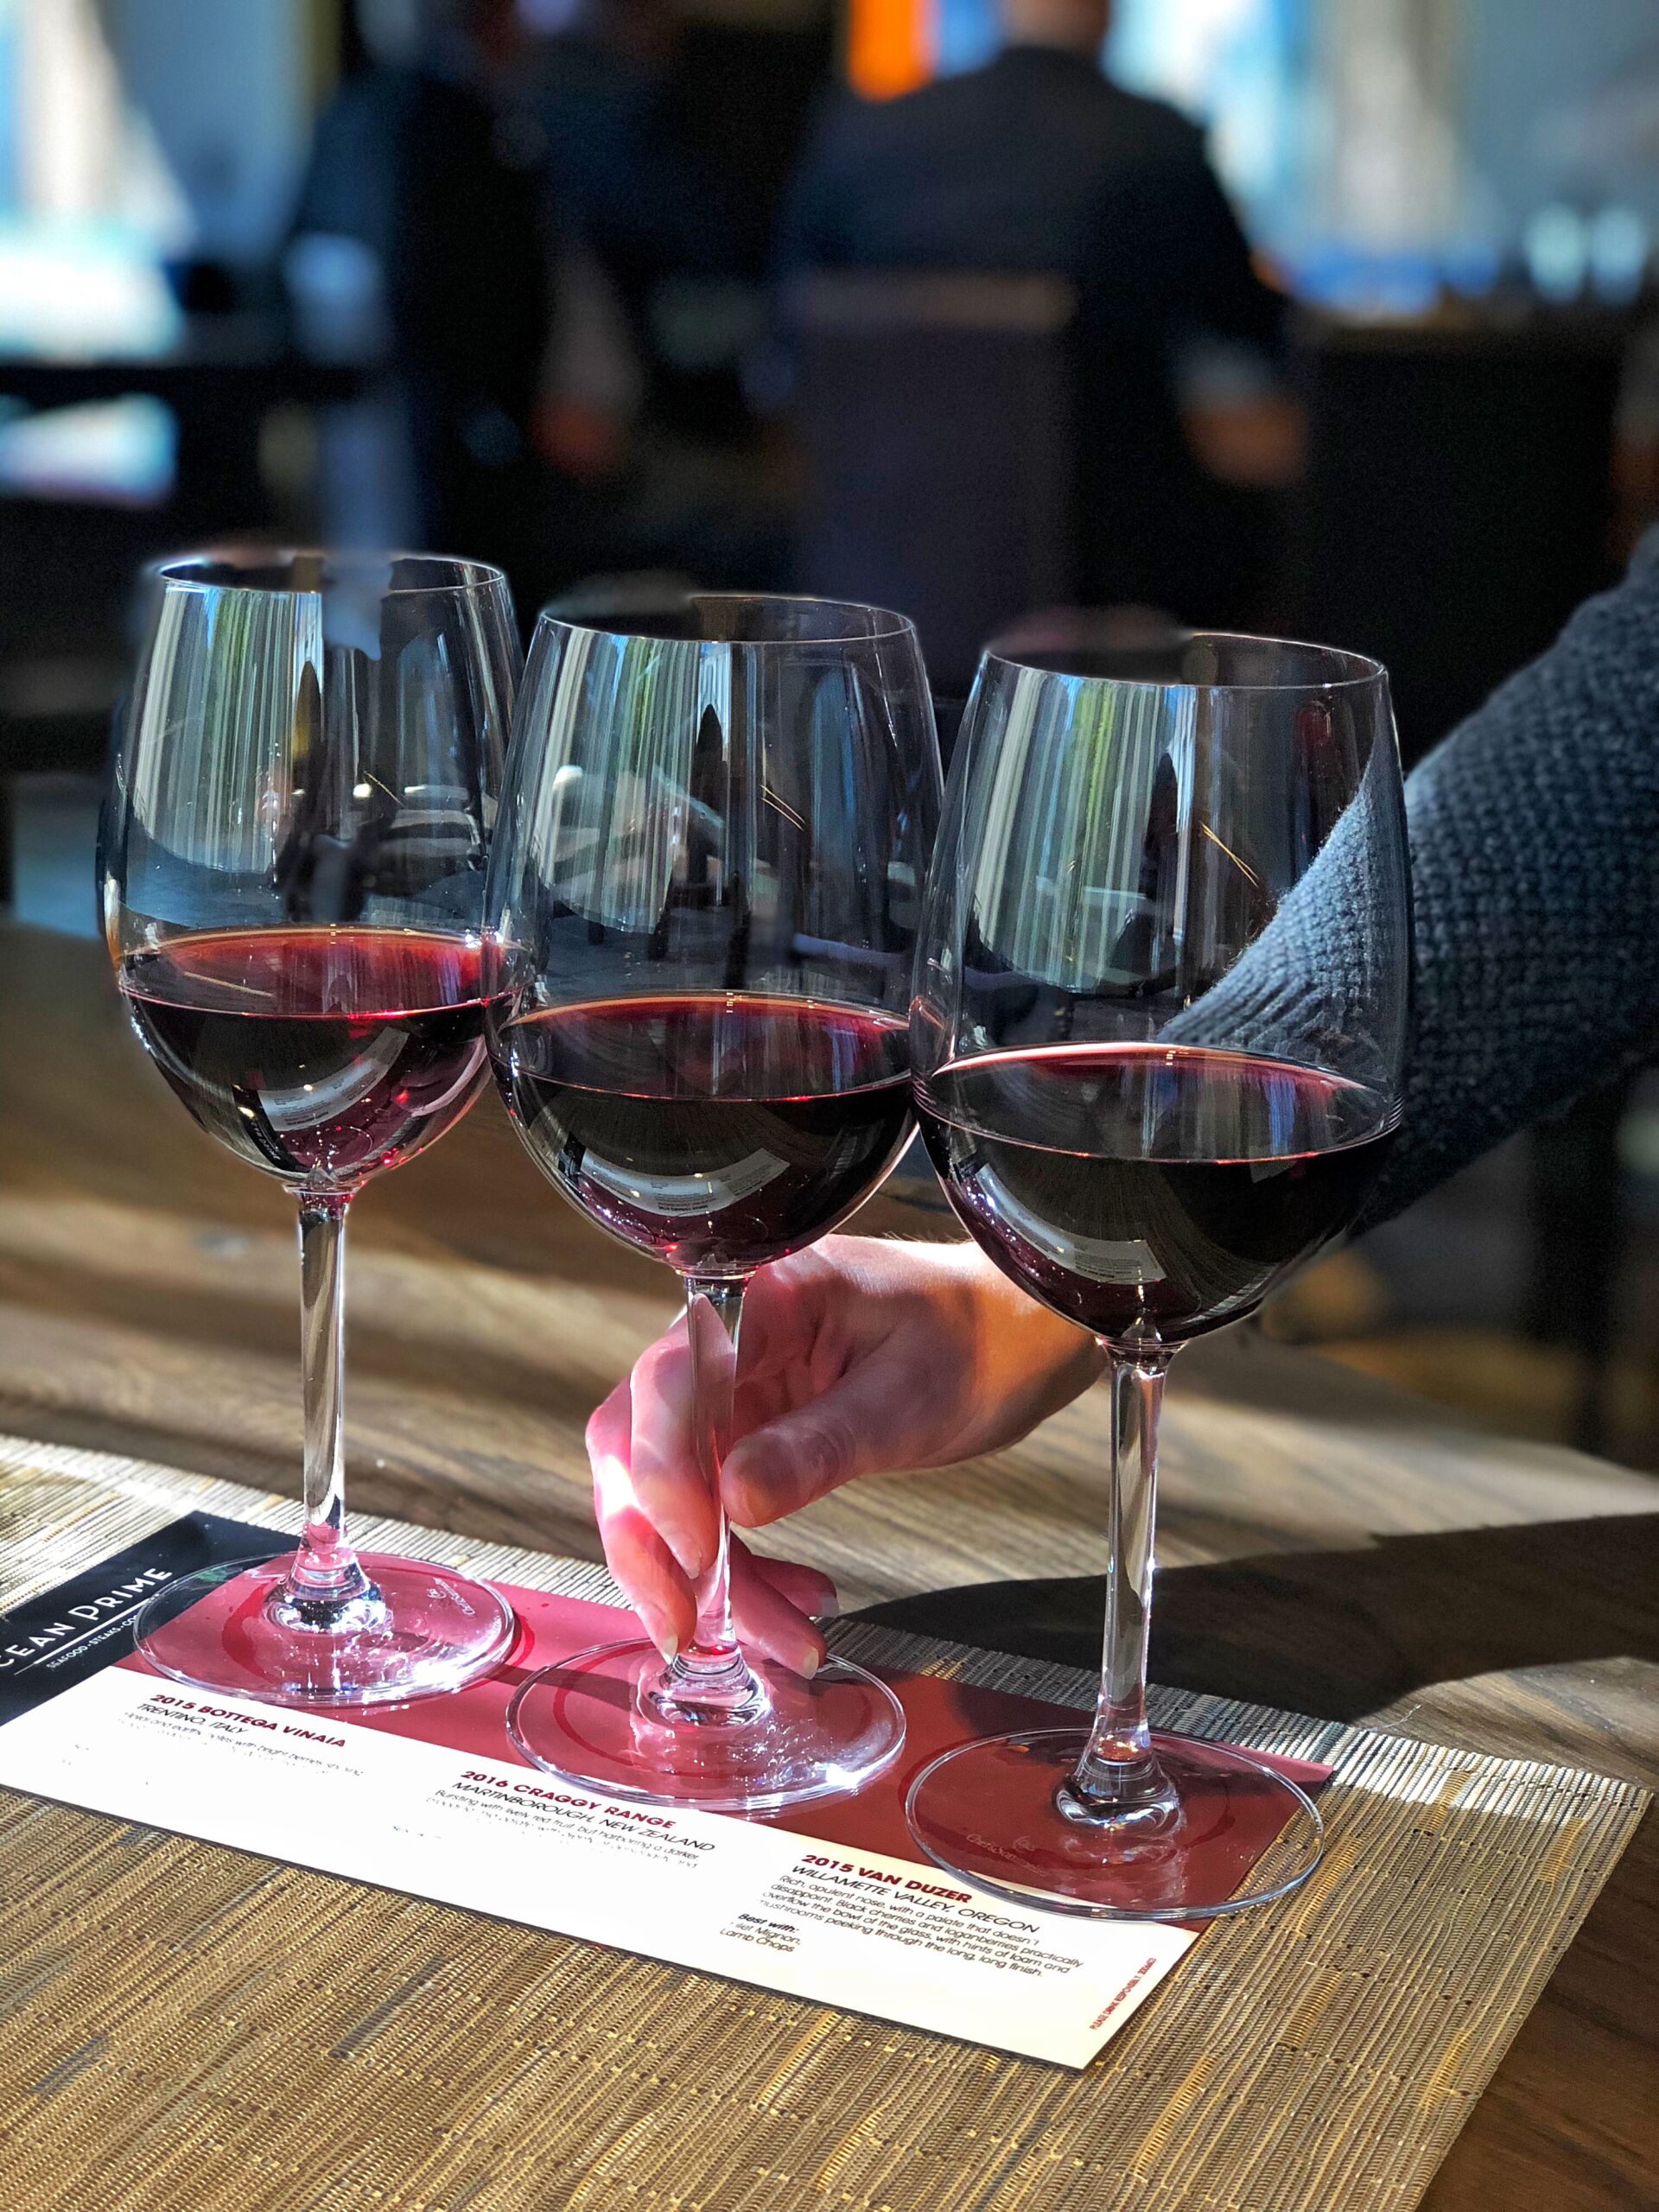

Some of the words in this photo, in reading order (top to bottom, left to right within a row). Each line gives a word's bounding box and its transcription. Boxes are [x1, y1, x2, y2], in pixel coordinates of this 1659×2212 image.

[67, 1567, 173, 1621] PRIME
[46, 1645, 88, 1669] SEAFOOD
[89, 1626, 122, 1645] STEAKS
[137, 1703, 207, 1726] TRENTINO,
[208, 1721, 249, 1734] ITALY
[149, 1694, 197, 1710] 2015
[197, 1706, 278, 1731] BOTTEGA
[283, 1726, 346, 1747] VINAIA
[435, 1789, 480, 1806] Bursting
[531, 1815, 552, 1823] red
[452, 1782, 595, 1824] MARTINBOROUGH,
[599, 1819, 642, 1833] NEW
[638, 1828, 716, 1851] ZEALAND
[461, 1770, 509, 1788] 2016
[513, 1784, 601, 1810] CRAGGY
[604, 1806, 677, 1829] RANGE
[779, 1874, 806, 1888] Rich,
[808, 1882, 855, 1900] opulent
[888, 1904, 914, 1916] with
[925, 1914, 964, 1929] palate
[967, 1923, 992, 1935] that
[791, 1865, 892, 1897] WILLAMETTE
[893, 1891, 957, 1913] VALLEY,
[957, 1908, 1040, 1933] OREGON
[801, 1854, 855, 1873] 2015
[858, 1866, 903, 1886] VAN
[904, 1879, 973, 1904] DUZER
[719, 1927, 755, 1942] Lamb
[755, 1936, 796, 1954] Chops
[737, 1912, 768, 1925] Best
[754, 1926, 802, 1947] Mignon,
[762, 1891, 811, 1908] overflow
[810, 1903, 832, 1915] the
[832, 1908, 862, 1922] bowl
[863, 1916, 878, 1925] of
[879, 1920, 899, 1931] the
[899, 1926, 933, 1941] glass,
[935, 1934, 963, 1947] with
[963, 1941, 994, 1955] hints
[994, 1950, 1011, 1960] of
[1009, 1953, 1043, 1968] loam
[1043, 1962, 1071, 1974] and
[771, 1884, 833, 1906] disappoint.
[835, 1900, 868, 1914] Black
[868, 1909, 916, 1926] cherries
[917, 1920, 944, 1932] and
[944, 1927, 1020, 1953] loganberries
[1019, 1947, 1085, 1968] practically
[823, 1915, 875, 1936] peeking
[874, 1928, 925, 1948] through
[924, 1941, 946, 1953] the
[946, 1946, 977, 1961] long,
[978, 1955, 1008, 1970] long
[1008, 1962, 1044, 1978] finish.
